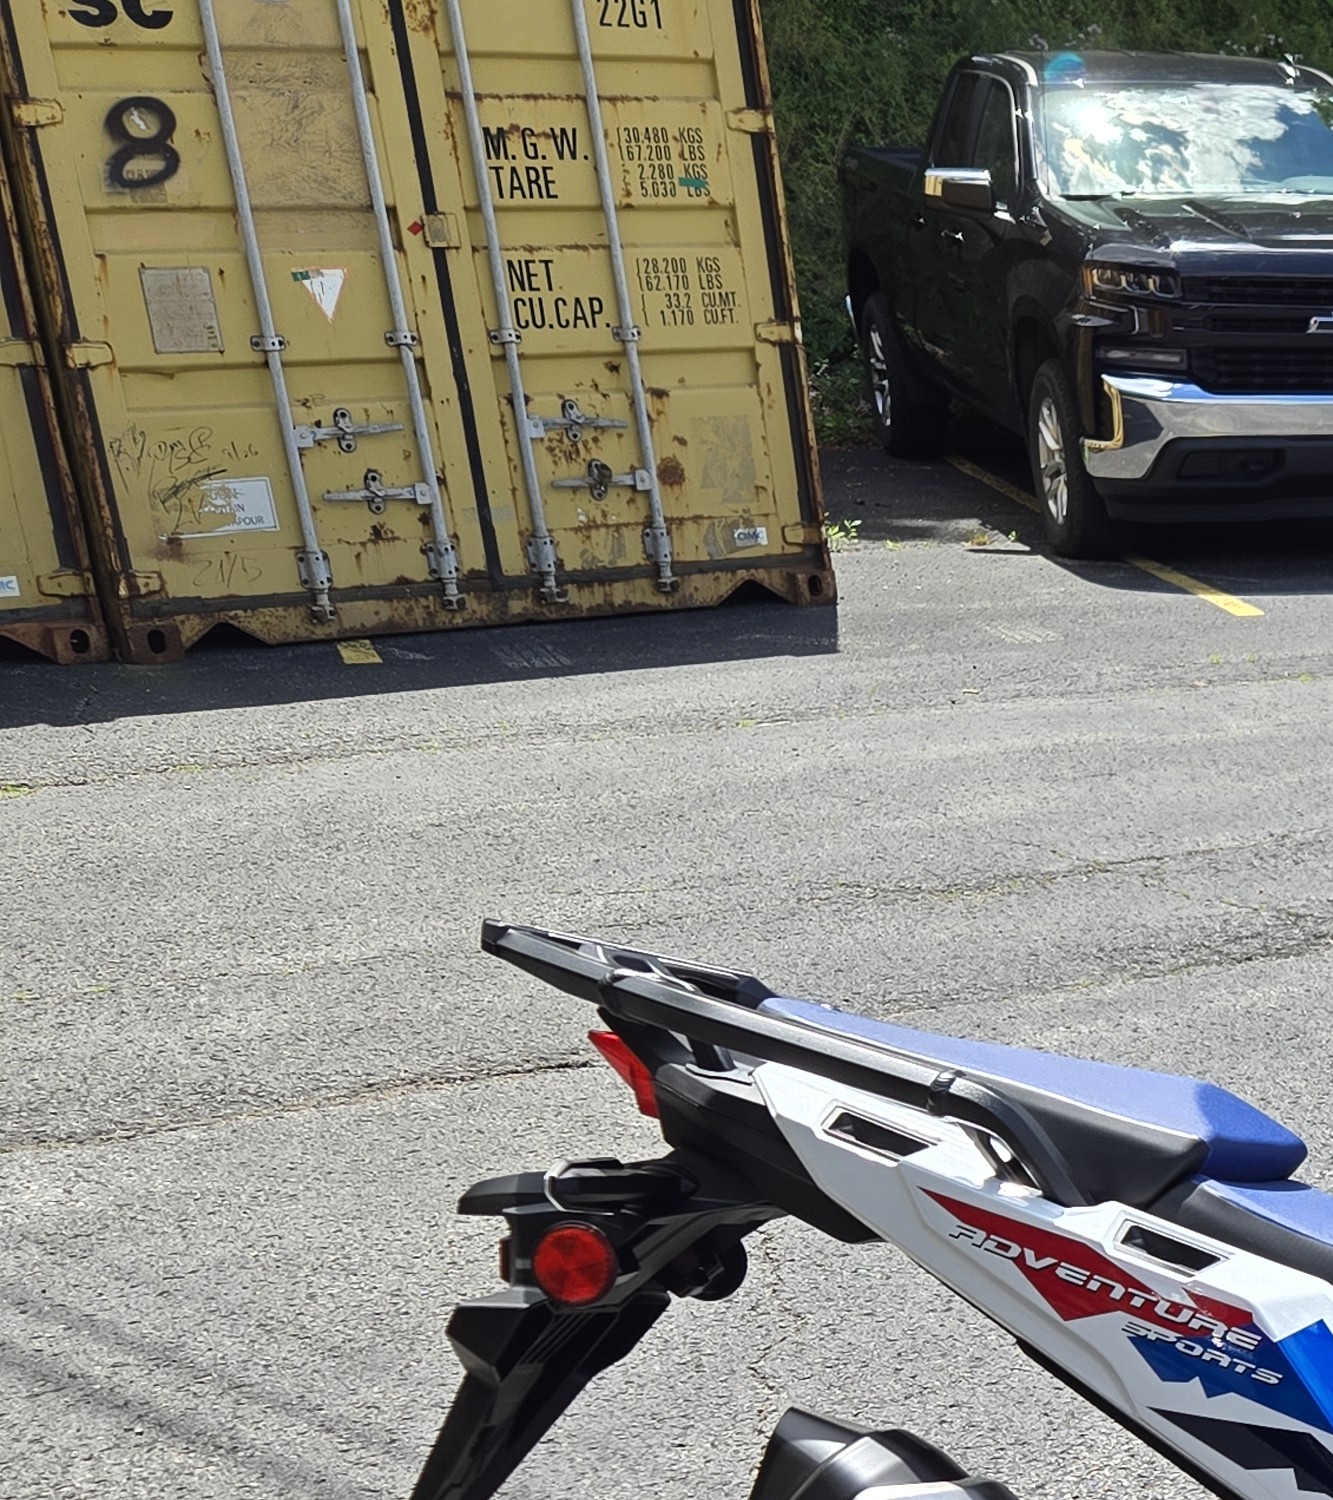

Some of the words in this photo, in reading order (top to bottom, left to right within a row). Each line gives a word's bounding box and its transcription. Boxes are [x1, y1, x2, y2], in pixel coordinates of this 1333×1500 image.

[596, 0, 662, 29] 22G1
[104, 96, 181, 188] 8
[623, 127, 669, 144] 30.480
[678, 127, 704, 144] KGS
[626, 145, 672, 161] 67.200
[680, 145, 706, 161] LBS
[489, 166, 559, 199] TARE
[638, 163, 674, 180] 2.280
[683, 163, 709, 180] KGS
[507, 259, 554, 292] NET
[643, 257, 687, 274] 28.200
[696, 257, 721, 274] KGS
[645, 275, 690, 291] 62.170
[698, 274, 723, 290] LBS
[513, 296, 612, 329] CU.CAP.
[664, 293, 691, 309] 33.2
[660, 310, 694, 327] 1.170
[949, 1224, 1263, 1351] ADVENTURE
[1121, 1321, 1284, 1386] SPORTS
